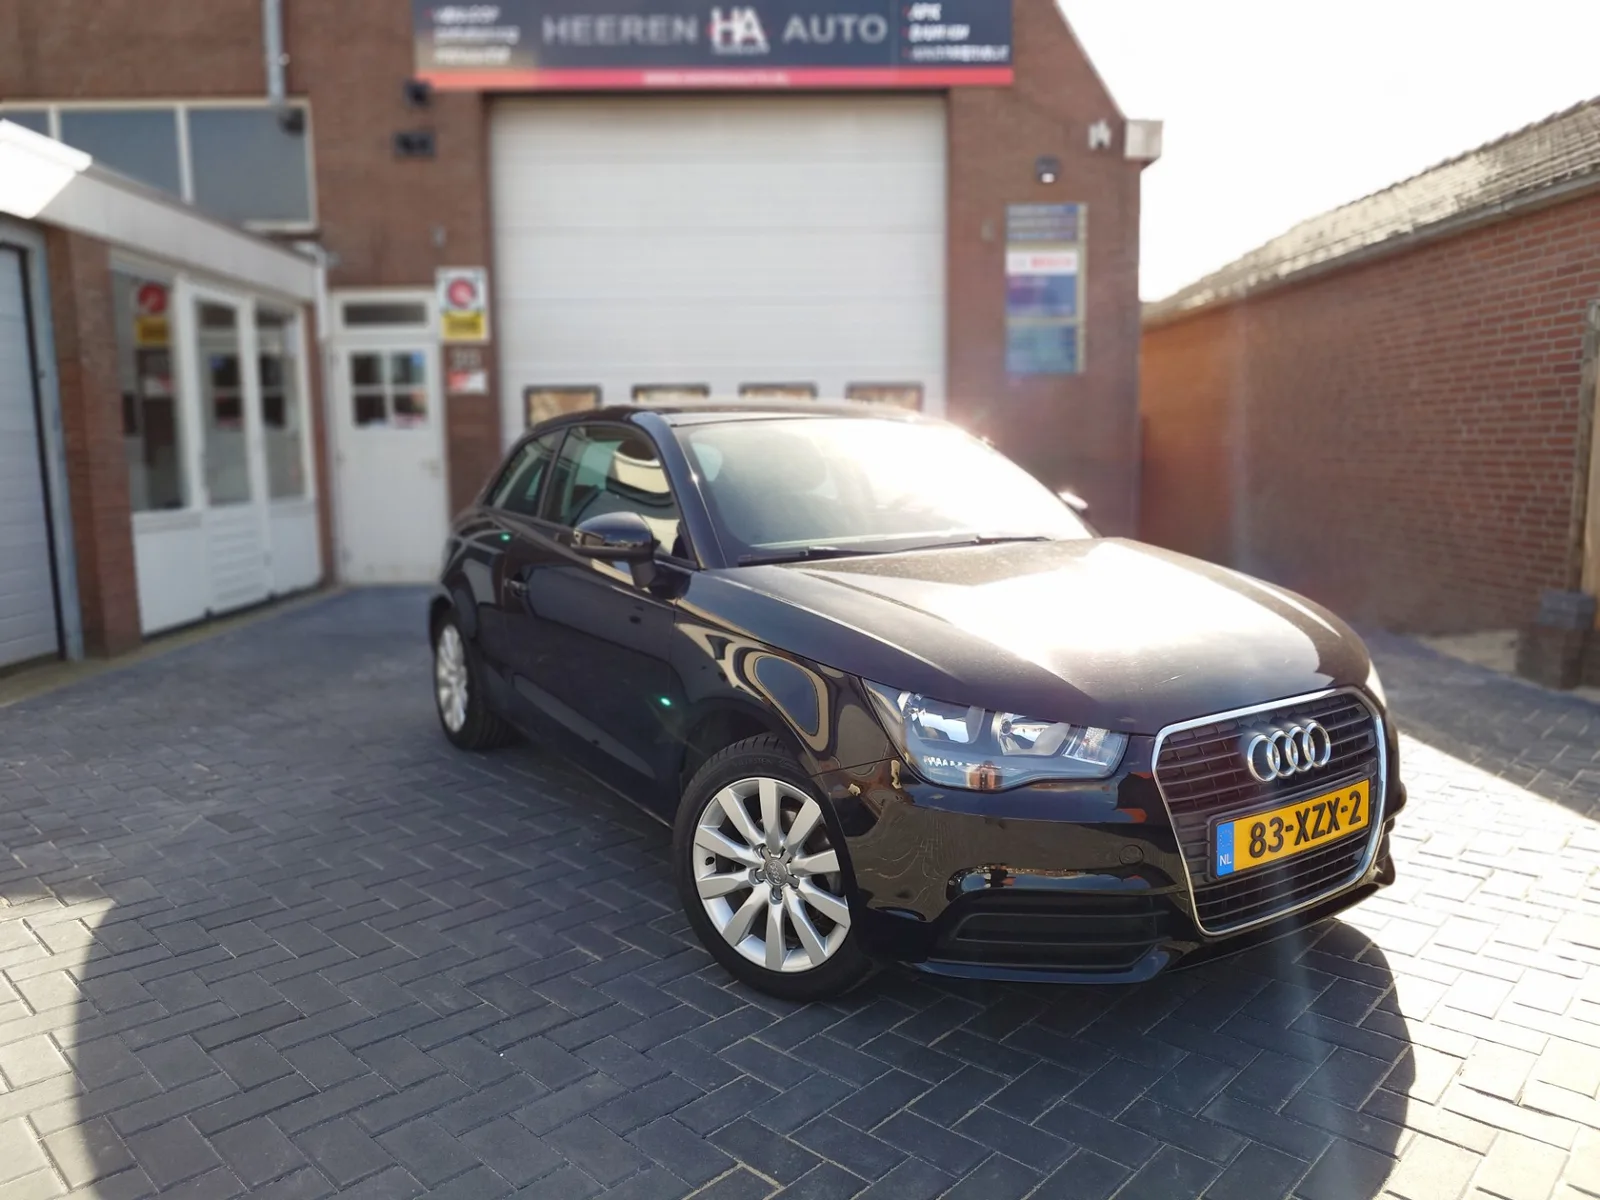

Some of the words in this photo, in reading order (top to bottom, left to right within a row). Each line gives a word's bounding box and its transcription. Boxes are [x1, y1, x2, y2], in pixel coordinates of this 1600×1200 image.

[542, 14, 698, 45] HEEREN
[711, 6, 768, 48] HA
[782, 14, 888, 44] AUTO
[1249, 790, 1362, 859] 83-XZX-2
[1219, 854, 1232, 867] NL
